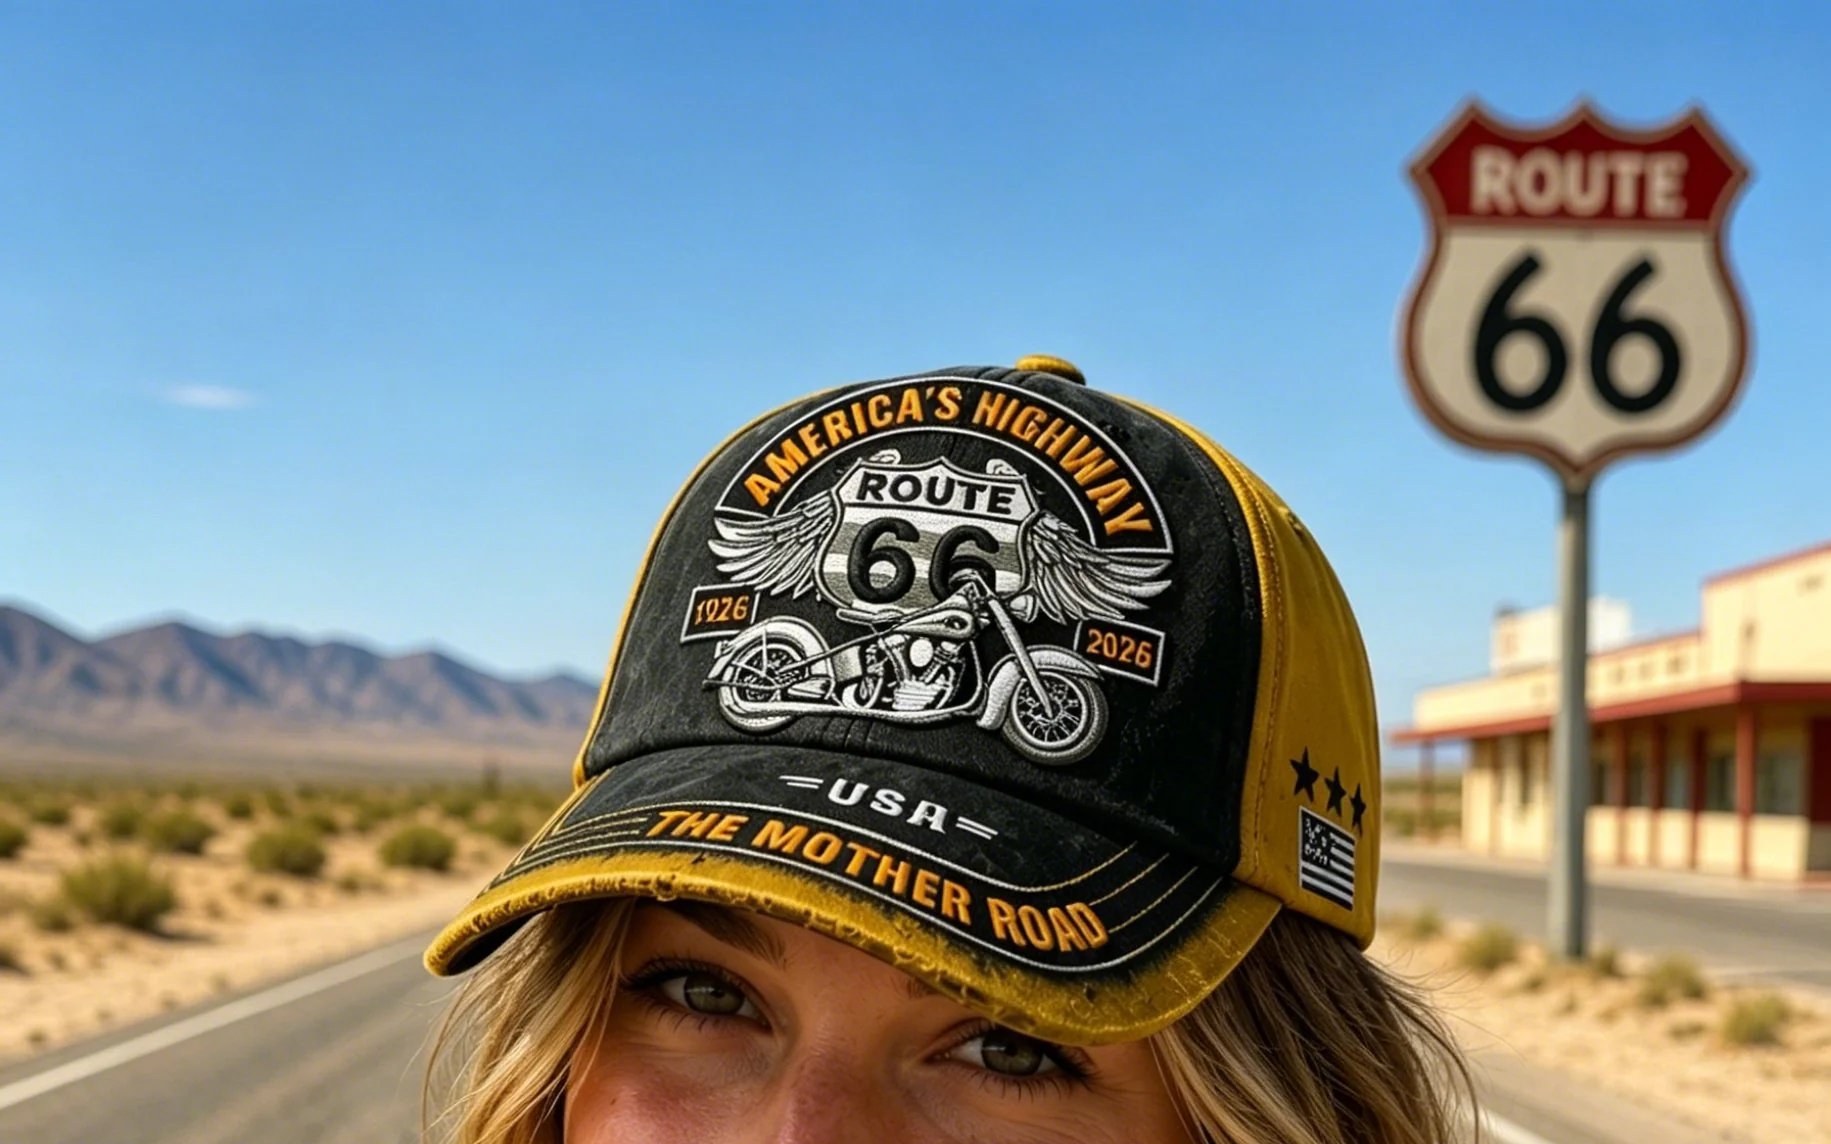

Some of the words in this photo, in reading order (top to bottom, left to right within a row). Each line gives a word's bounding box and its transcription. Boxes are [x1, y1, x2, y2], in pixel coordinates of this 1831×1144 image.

[1469, 145, 1689, 218] ROUTE
[1473, 254, 1681, 413] 66
[743, 385, 963, 507] AMERICA'S
[971, 389, 1154, 537] HIGHWAY
[856, 471, 1017, 515] ROUTE
[847, 516, 1000, 604] 66
[1086, 628, 1154, 669] 2026
[827, 777, 947, 834] USA
[646, 809, 750, 842] THE
[750, 819, 972, 927] MOTHER
[985, 896, 1110, 953] ROAD
